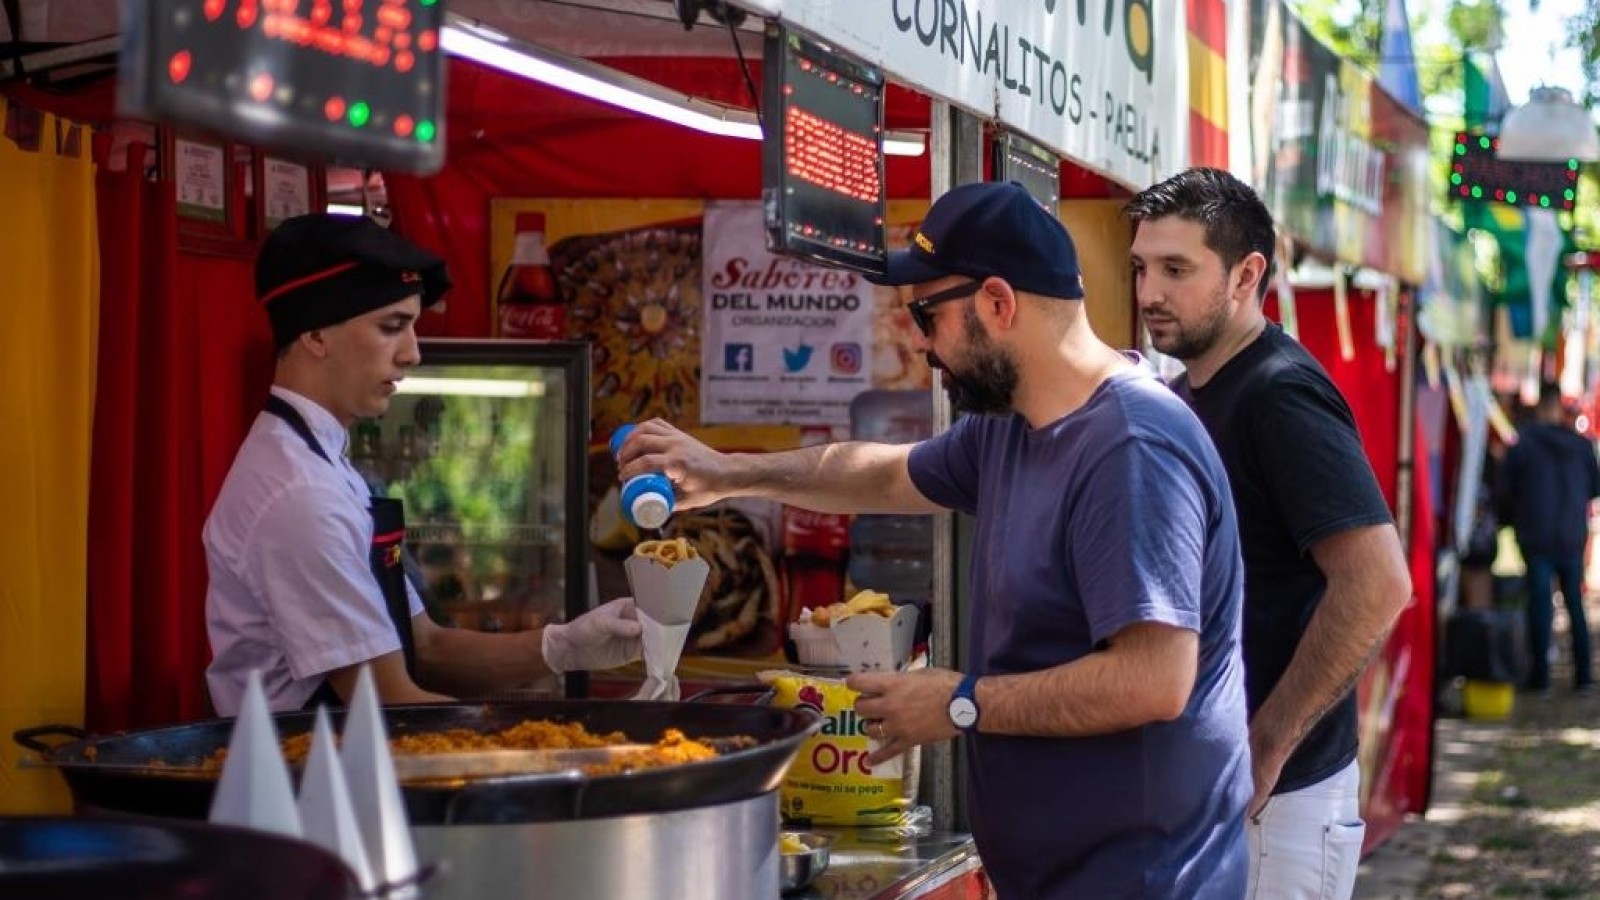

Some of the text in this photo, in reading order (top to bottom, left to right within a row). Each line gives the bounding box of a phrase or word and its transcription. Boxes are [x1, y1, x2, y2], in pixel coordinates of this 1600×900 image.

[1105, 91, 1159, 163] PAELLA
[712, 256, 857, 290] Sabores
[712, 294, 860, 312] DEL MUNDO
